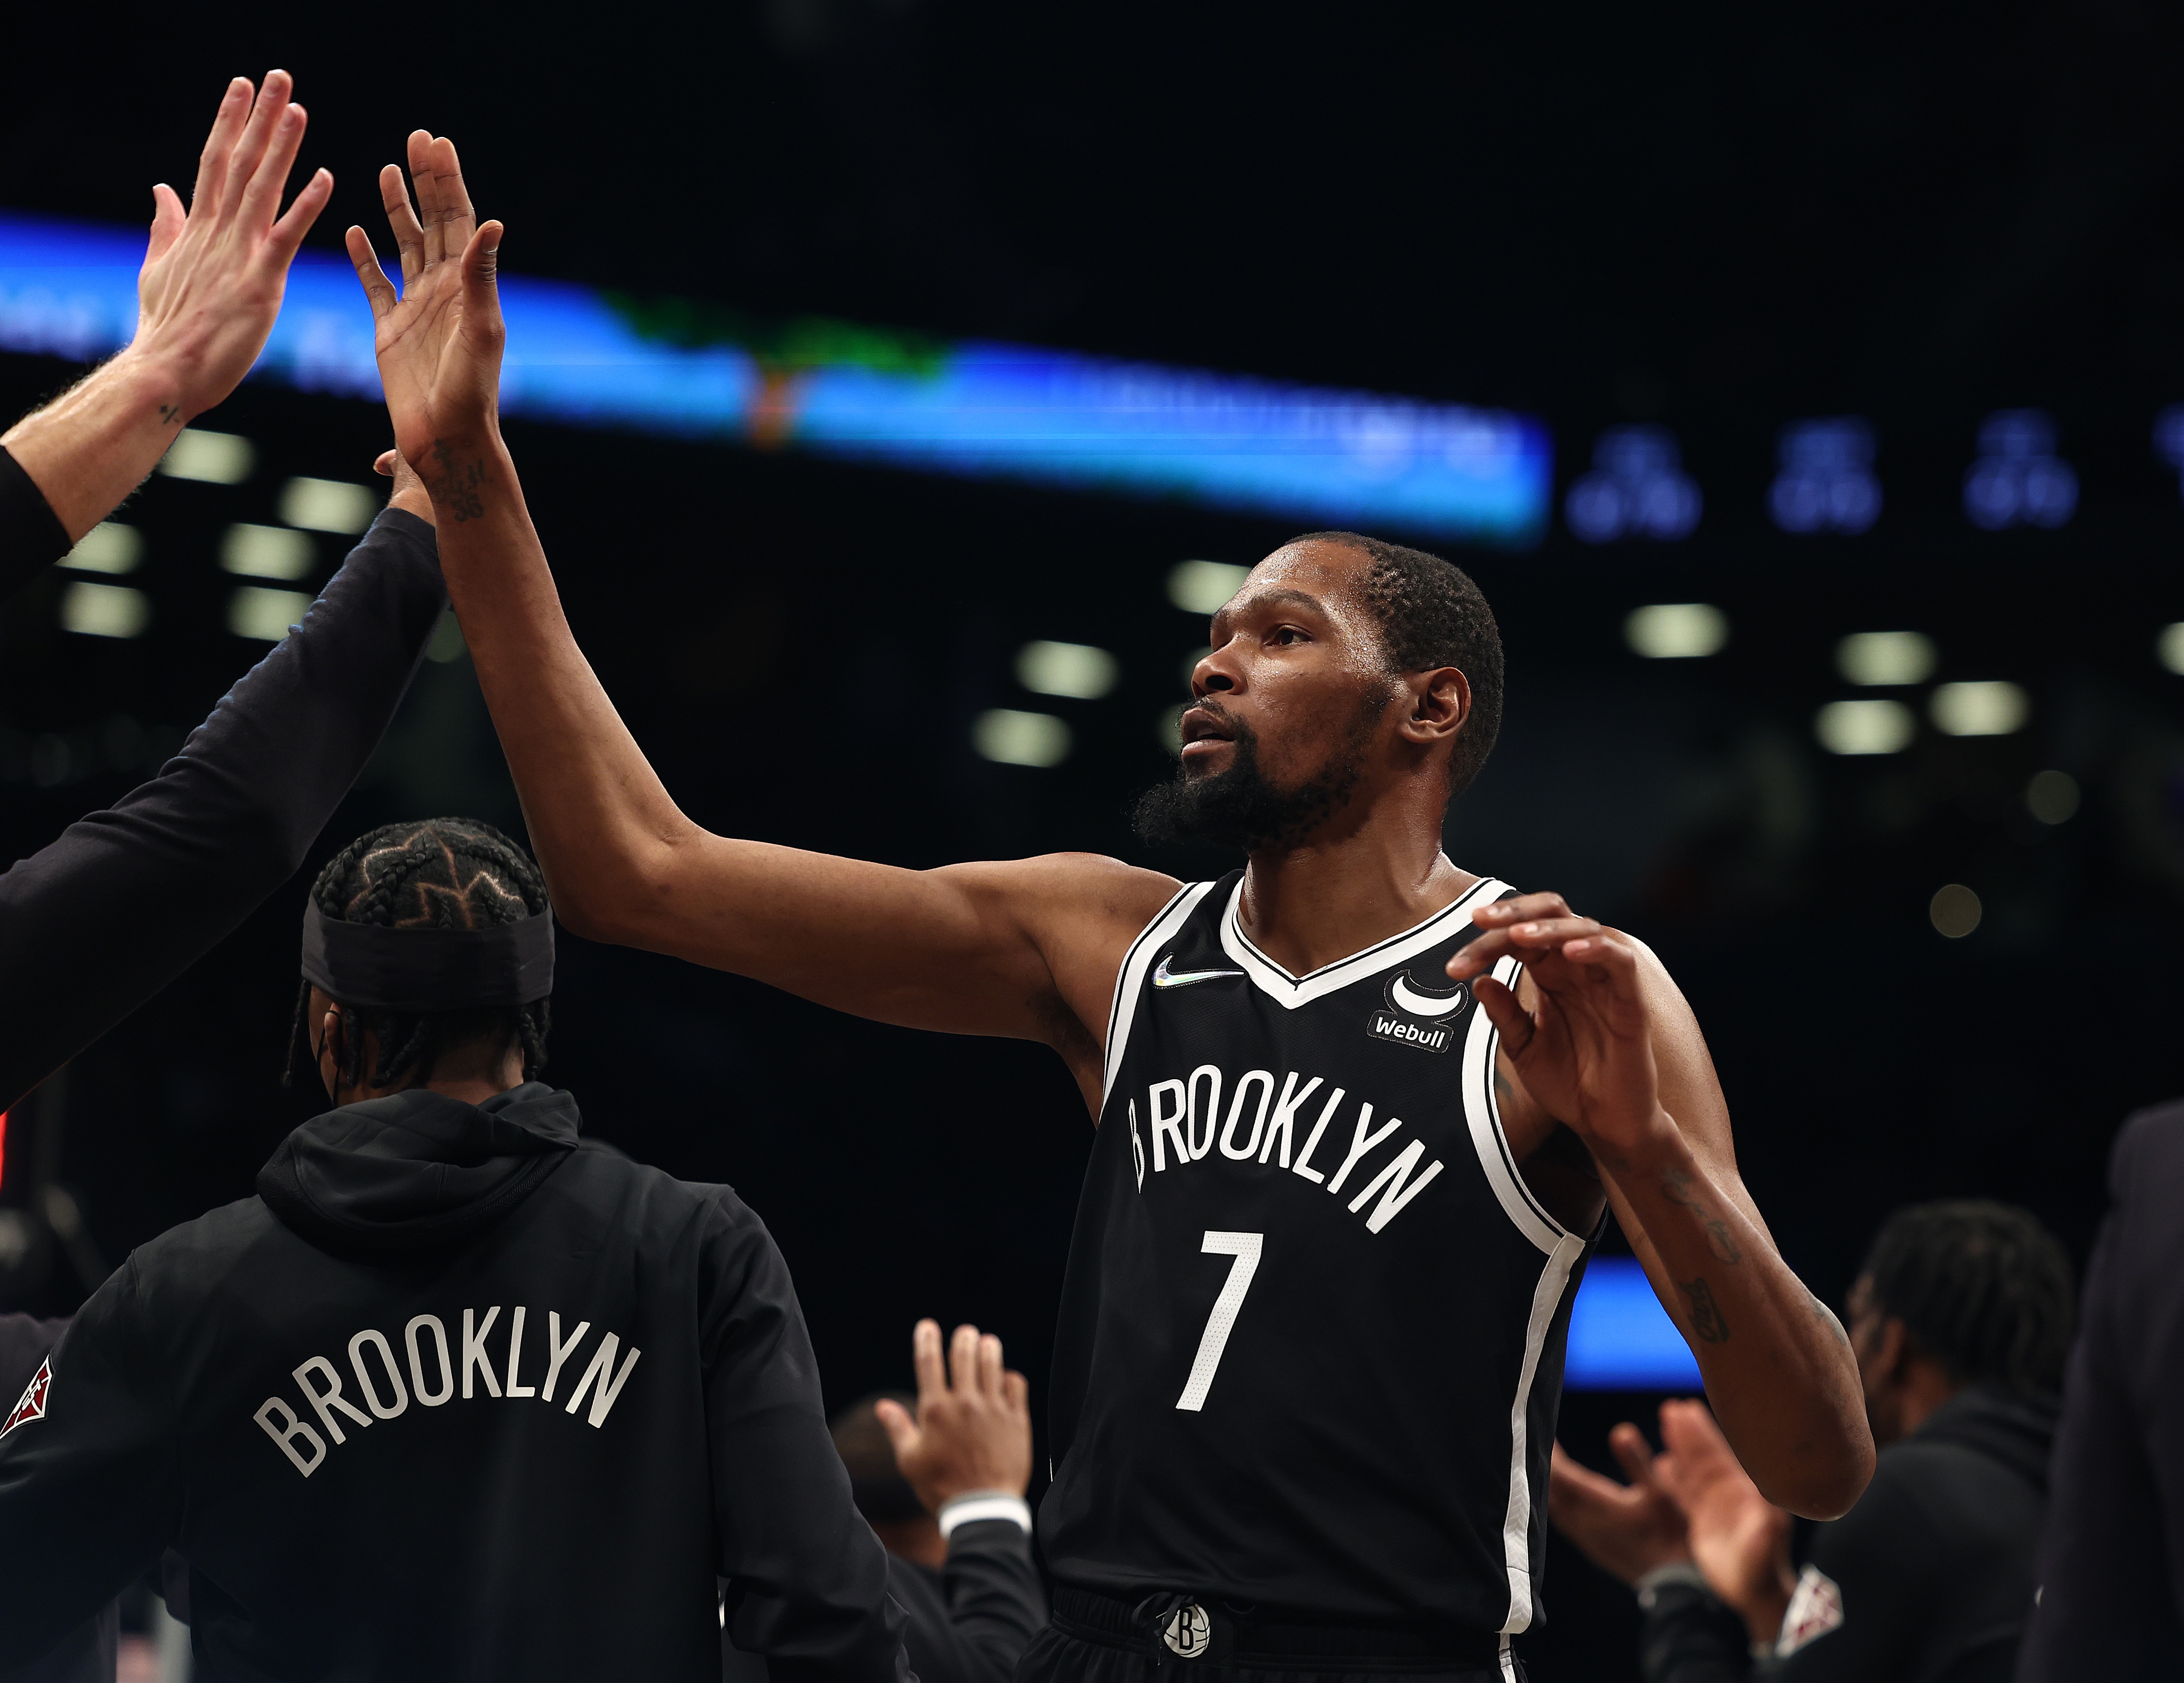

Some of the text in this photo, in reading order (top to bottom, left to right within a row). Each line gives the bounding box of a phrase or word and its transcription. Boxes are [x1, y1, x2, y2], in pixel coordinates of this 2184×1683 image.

[1375, 1016, 1446, 1048] Webull
[1128, 1064, 1444, 1235] BROOKLYN
[252, 1305, 642, 1478] BROOKLYN
[1175, 1230, 1264, 1412] 7
[1179, 1608, 1194, 1650] B
